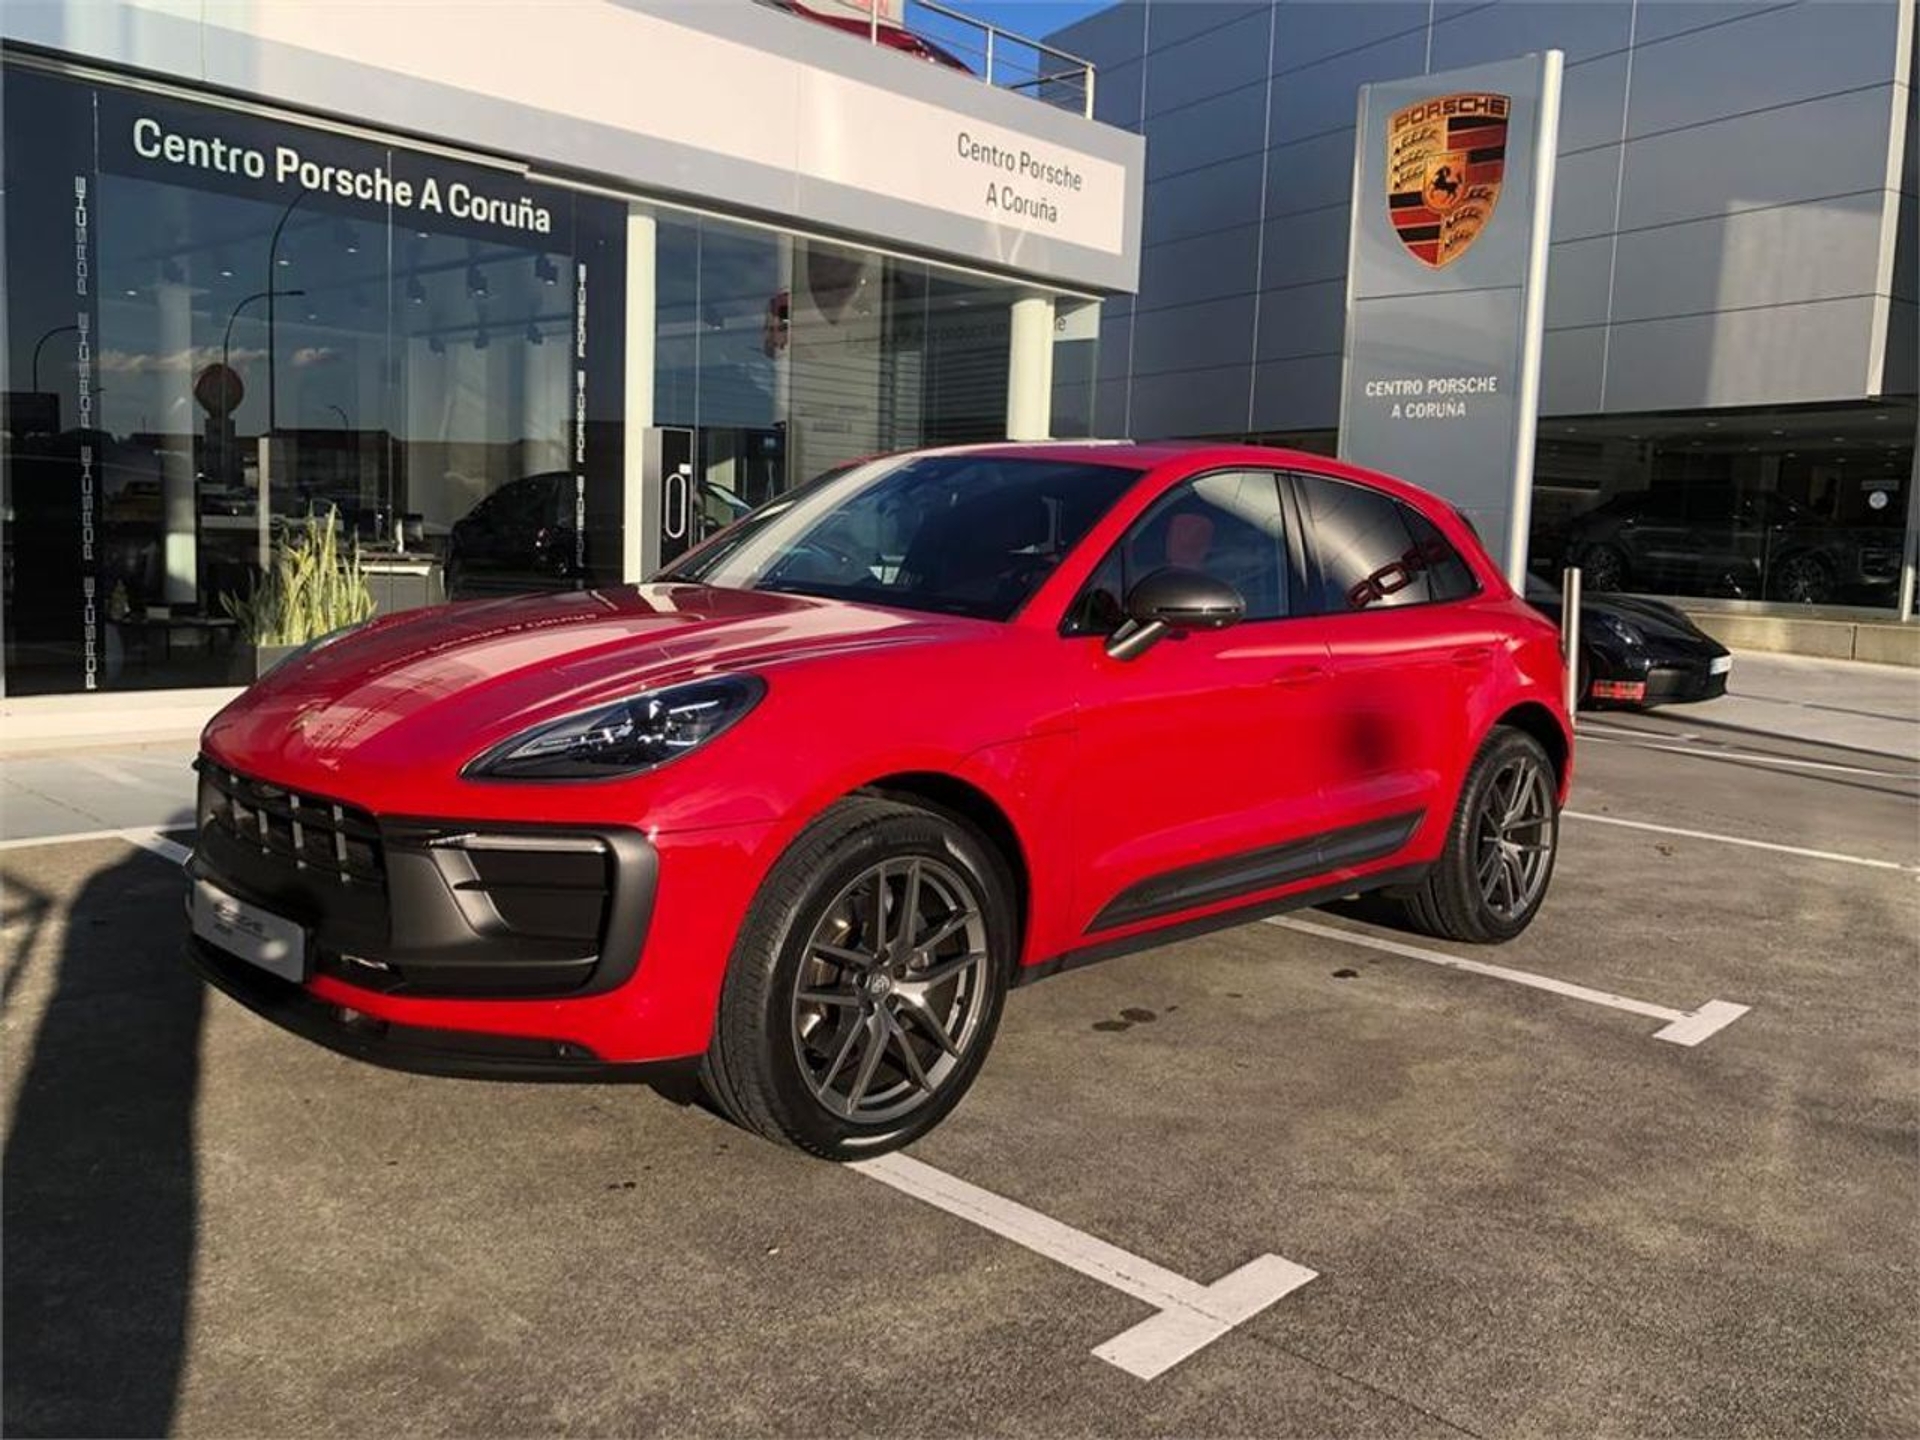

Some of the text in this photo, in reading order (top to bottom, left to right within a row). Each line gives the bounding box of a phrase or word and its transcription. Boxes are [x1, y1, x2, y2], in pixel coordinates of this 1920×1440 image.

[1394, 97, 1505, 132] PORSCHE
[133, 117, 551, 235] Centro Porsche A Coruña
[958, 132, 1082, 191] Centro Porsche
[986, 182, 1058, 223] A Coruña
[1365, 376, 1498, 397] CENTRO PORSCHE
[1390, 399, 1467, 419] A CORUÑA
[75, 176, 97, 690] PORSCHE PORSCHE PORSCHE PORSCHE
